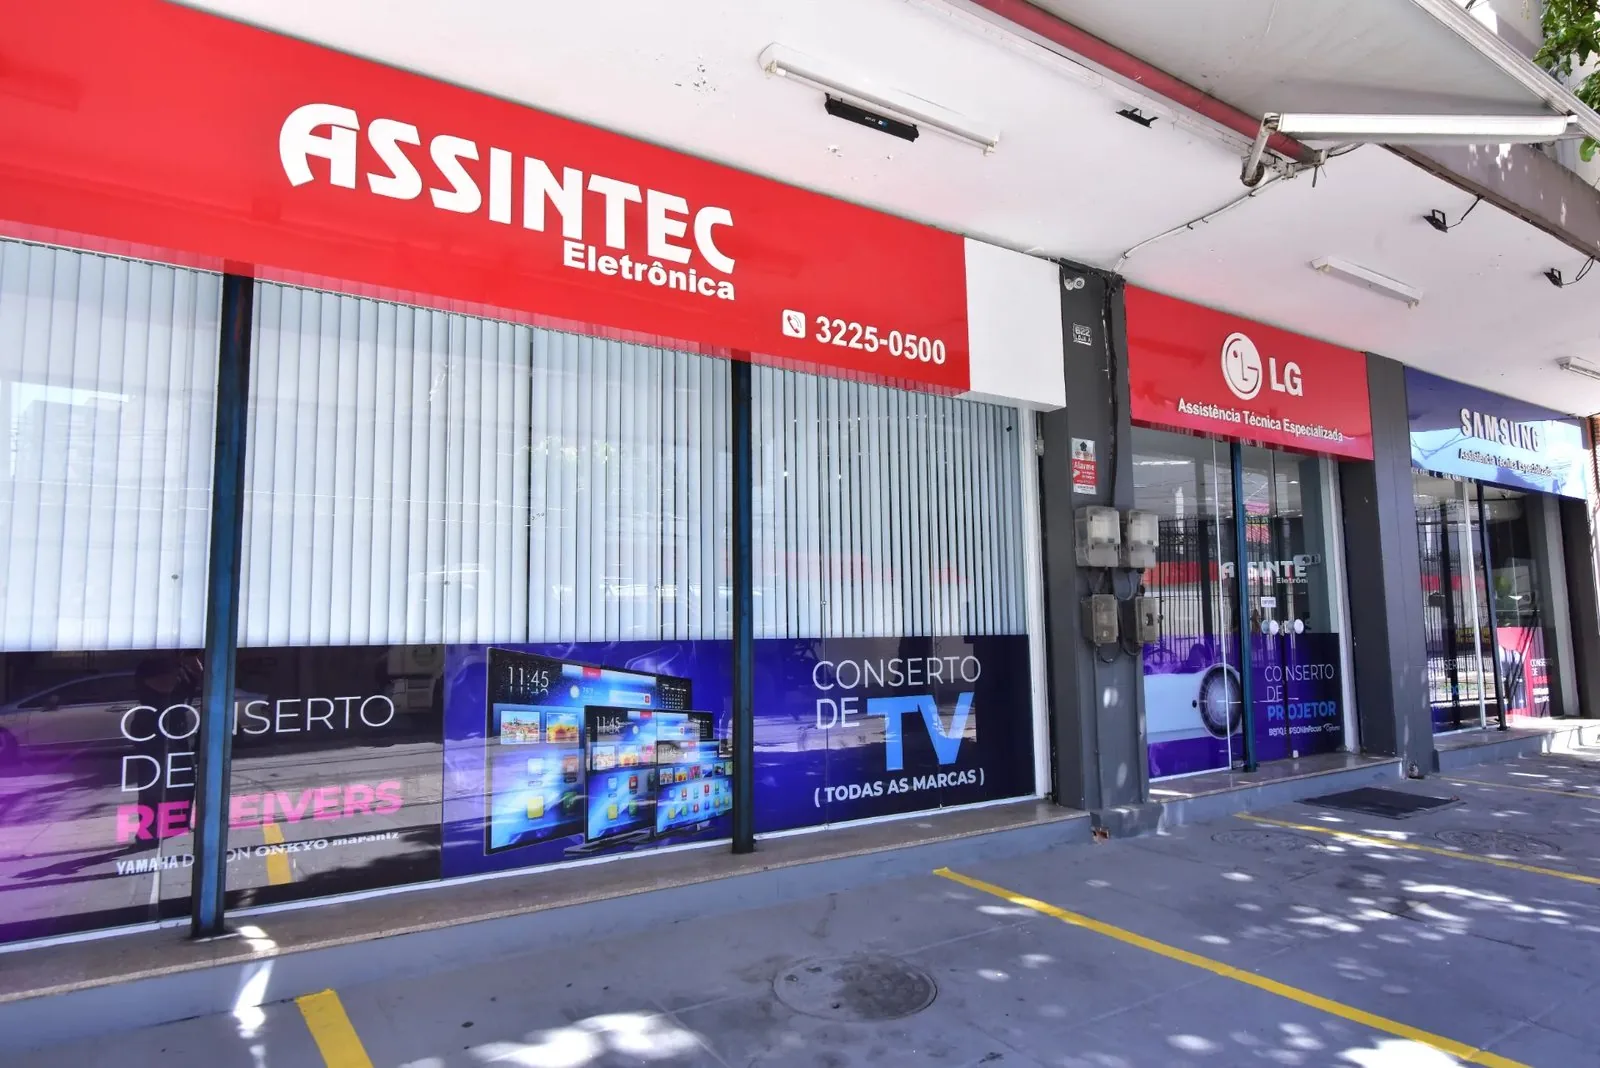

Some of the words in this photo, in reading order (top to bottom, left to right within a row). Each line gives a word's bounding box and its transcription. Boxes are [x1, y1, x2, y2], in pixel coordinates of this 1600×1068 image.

[279, 103, 736, 275] ASSINTEC
[563, 240, 736, 301] Eletrônica
[815, 316, 946, 365] 3225-0500
[1269, 357, 1303, 397] LG
[1178, 398, 1241, 424] Assistência
[1242, 410, 1282, 431] Técnica
[1283, 418, 1344, 443] Especializada
[1460, 408, 1540, 452] SAMSUNG
[508, 666, 549, 688] 11:45
[812, 655, 982, 691] CONSERTO
[1264, 663, 1335, 682] CONSERTO
[1266, 685, 1284, 702] DE
[1267, 700, 1337, 722] PROJETOR
[816, 697, 861, 730] DE
[866, 691, 975, 772] TV
[121, 751, 196, 792] DE
[824, 780, 884, 803] TODAS
[887, 777, 909, 796] AS
[912, 769, 977, 792] MARCAS
[115, 780, 404, 844] REEIVERS
[116, 854, 179, 876] YAMAHA
[182, 845, 250, 868] DON
[255, 838, 328, 857] ONKYO
